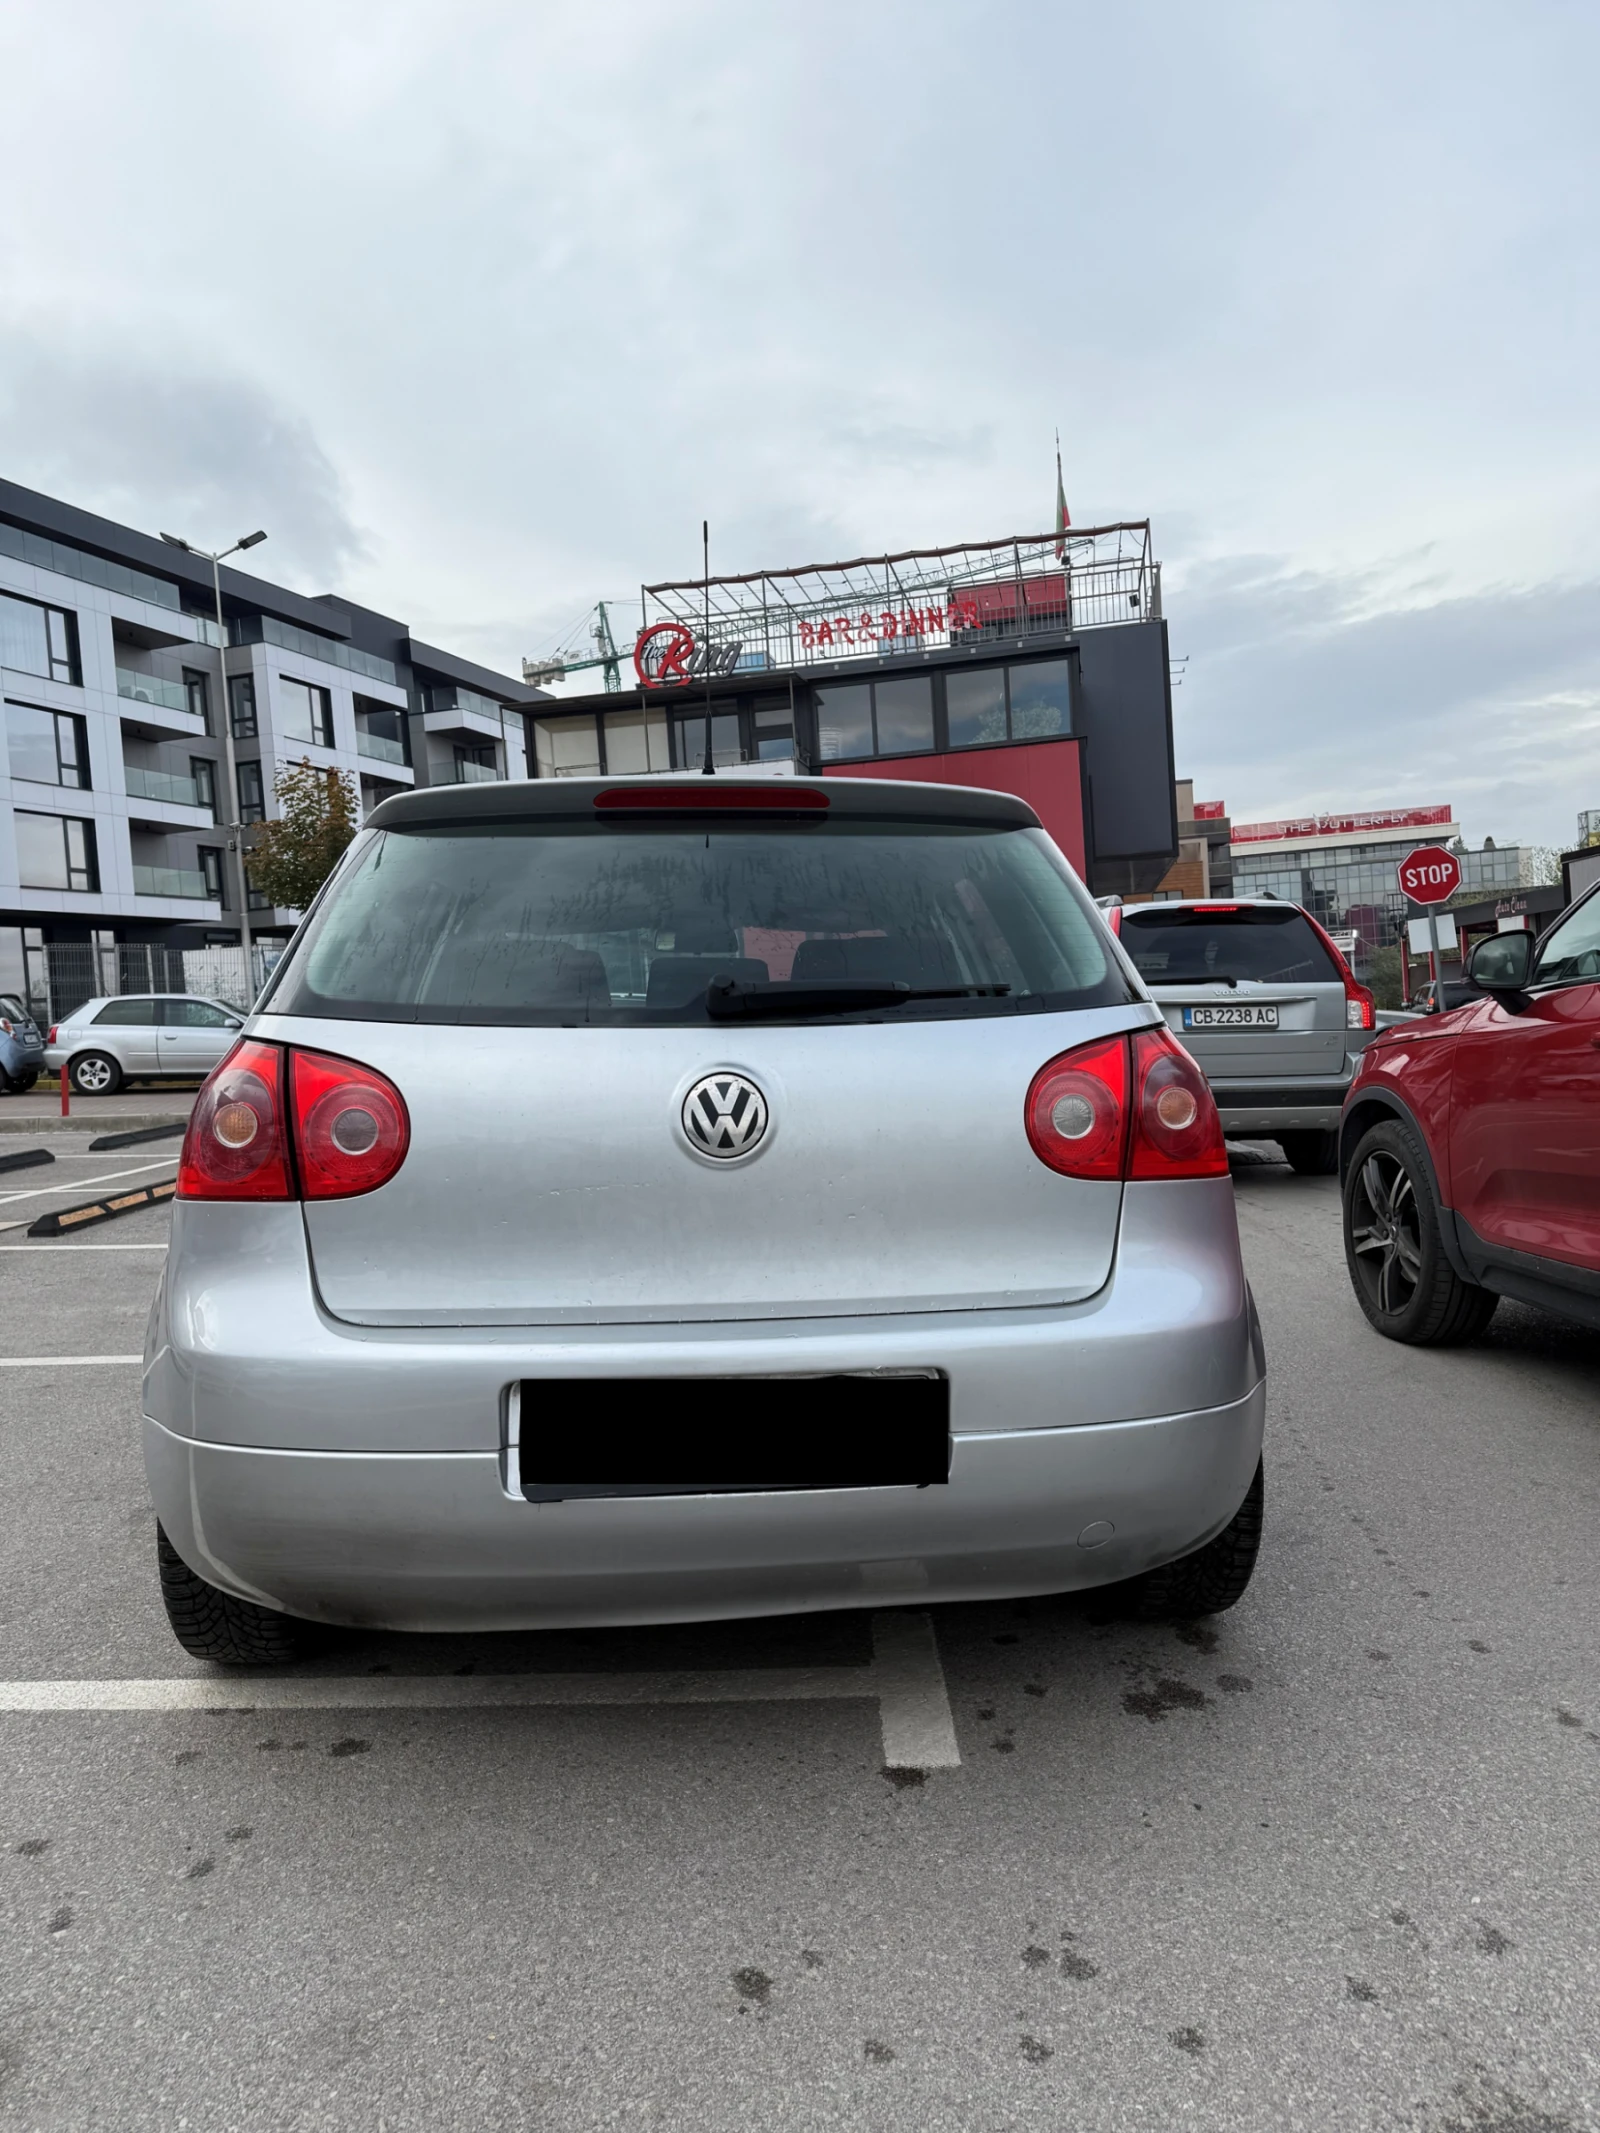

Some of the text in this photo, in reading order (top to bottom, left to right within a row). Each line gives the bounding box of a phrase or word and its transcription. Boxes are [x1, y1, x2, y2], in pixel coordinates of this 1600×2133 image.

[643, 645, 665, 658] The
[1282, 813, 1408, 833] THE BUTTERFLY
[1406, 863, 1453, 888] STOP
[1216, 1009, 1253, 1024] 2238
[1256, 1008, 1275, 1023] AC
